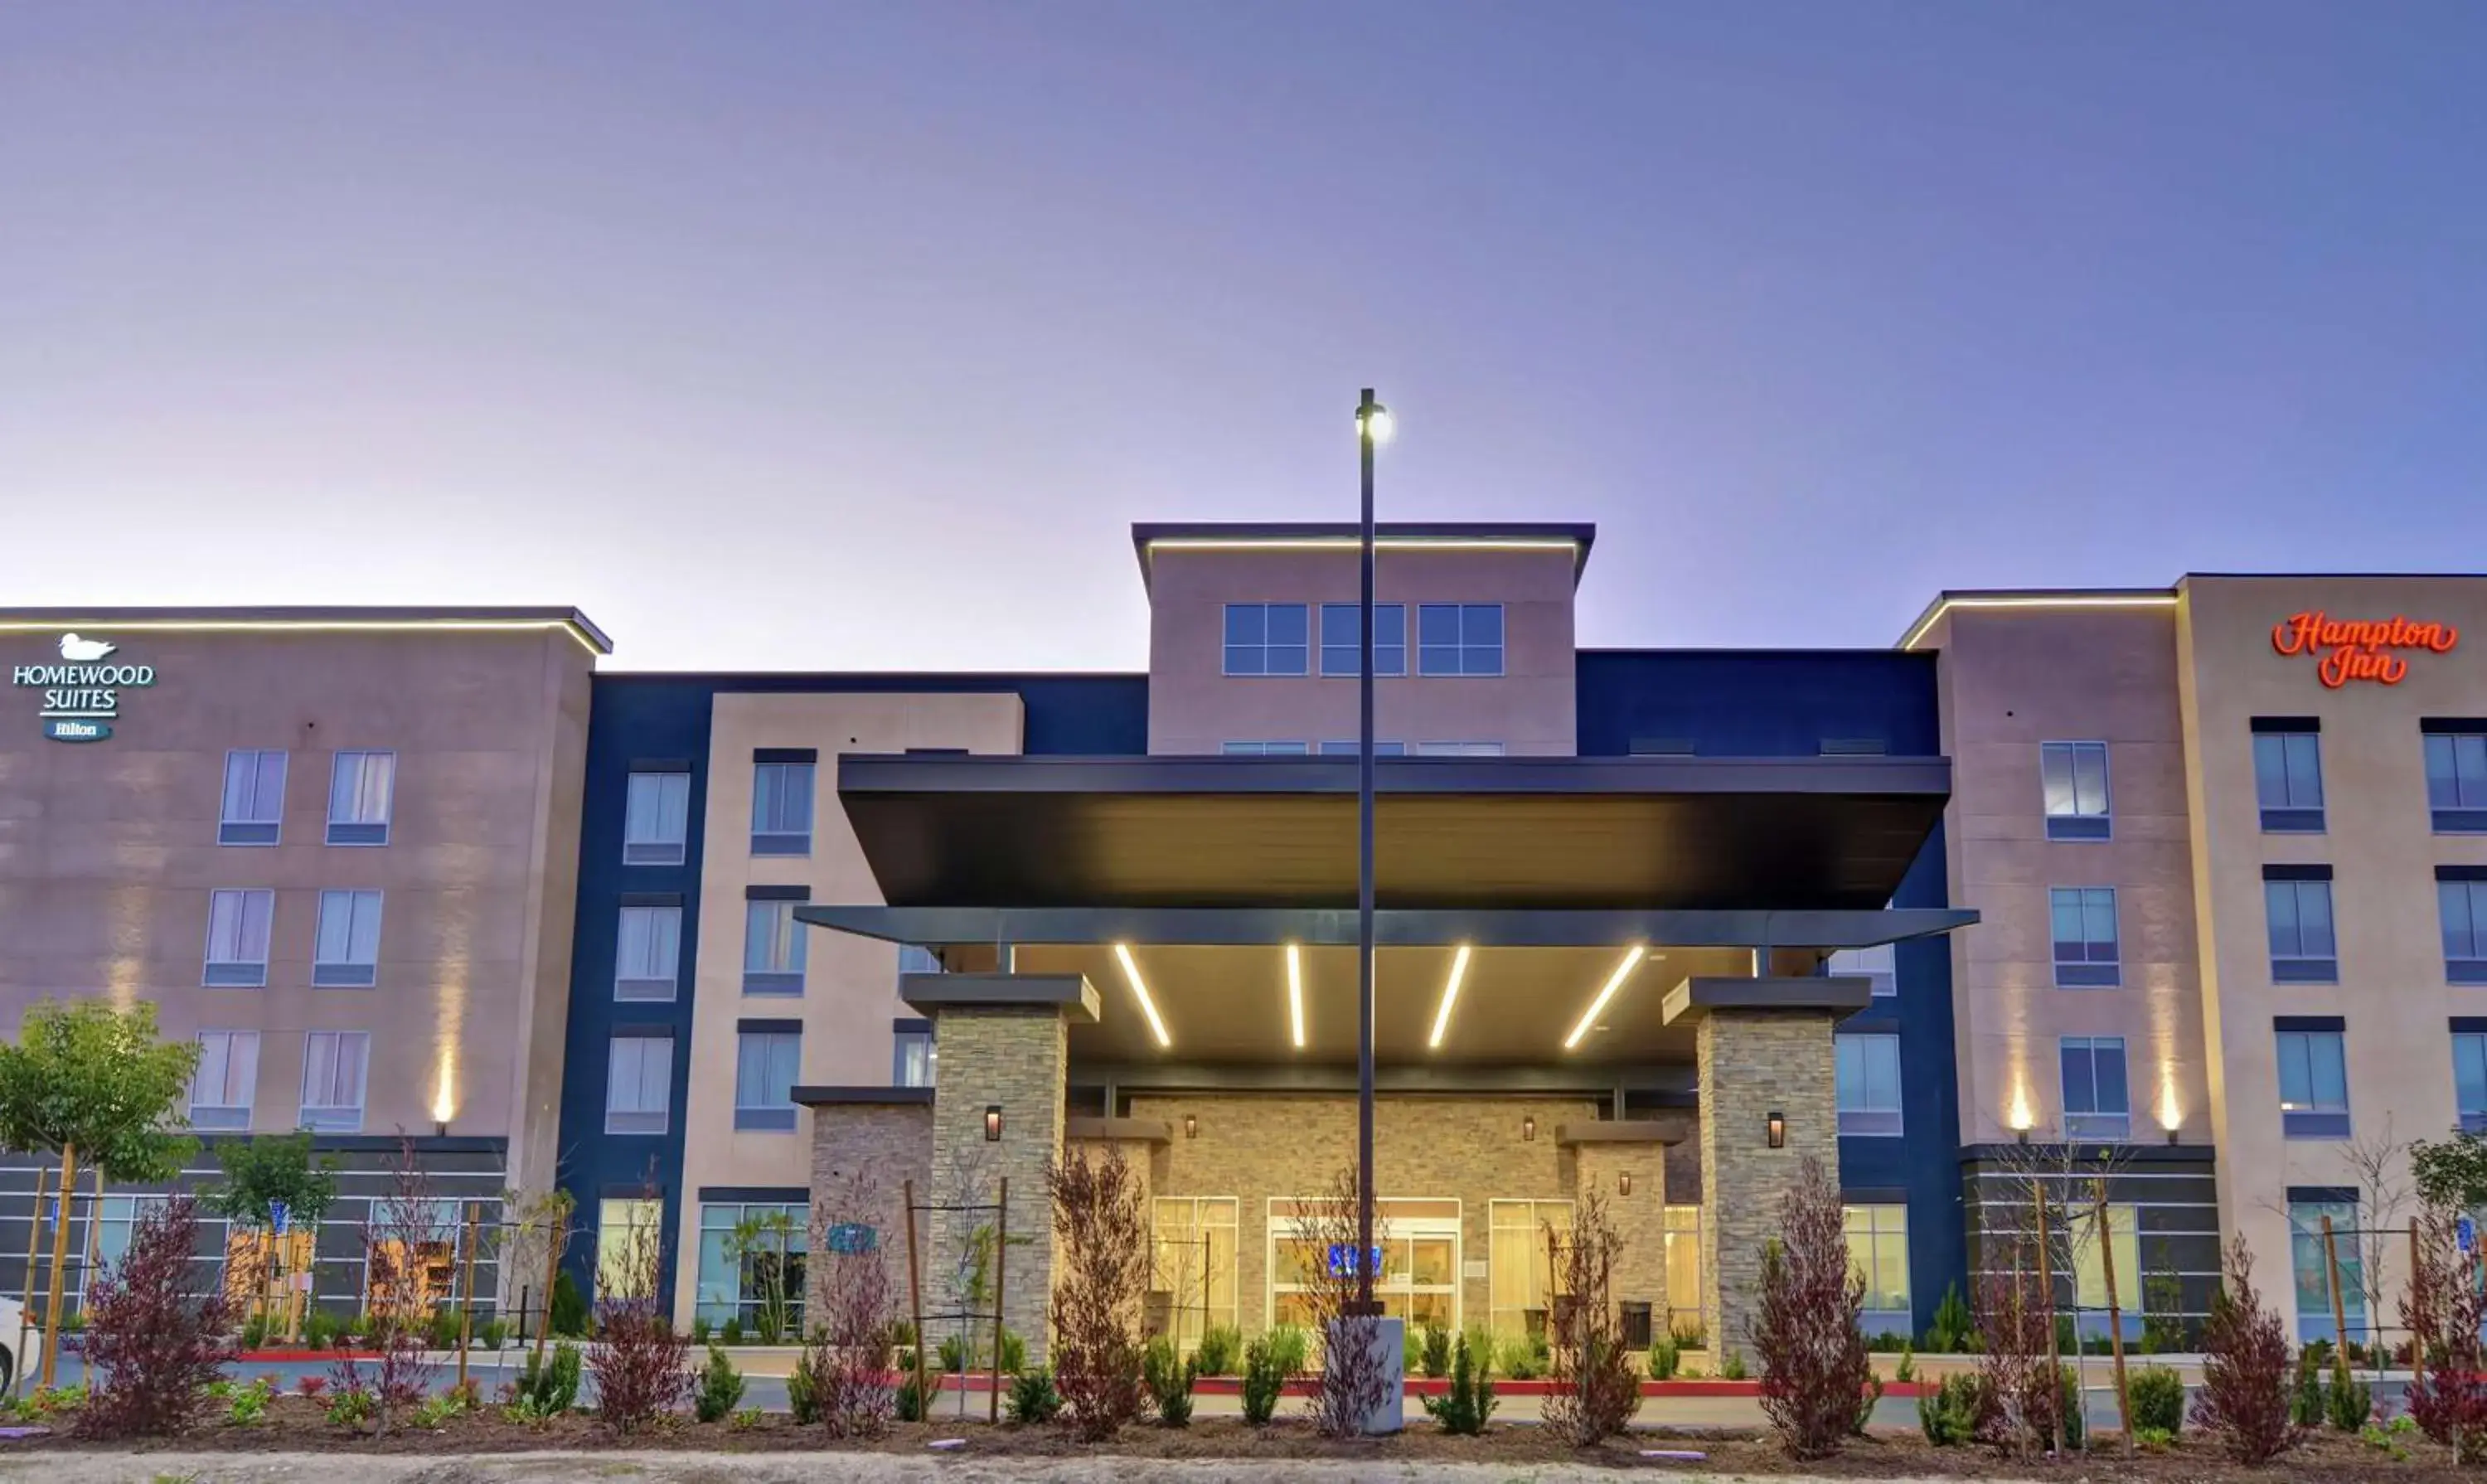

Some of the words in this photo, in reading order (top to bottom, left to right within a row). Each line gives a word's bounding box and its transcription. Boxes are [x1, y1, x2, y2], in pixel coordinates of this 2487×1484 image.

[2273, 610, 2457, 654] Hampton
[12, 666, 153, 685] HOMEWOOD
[2320, 645, 2406, 687] Inn
[43, 689, 115, 709] SUITES
[55, 722, 97, 735] Hilton
